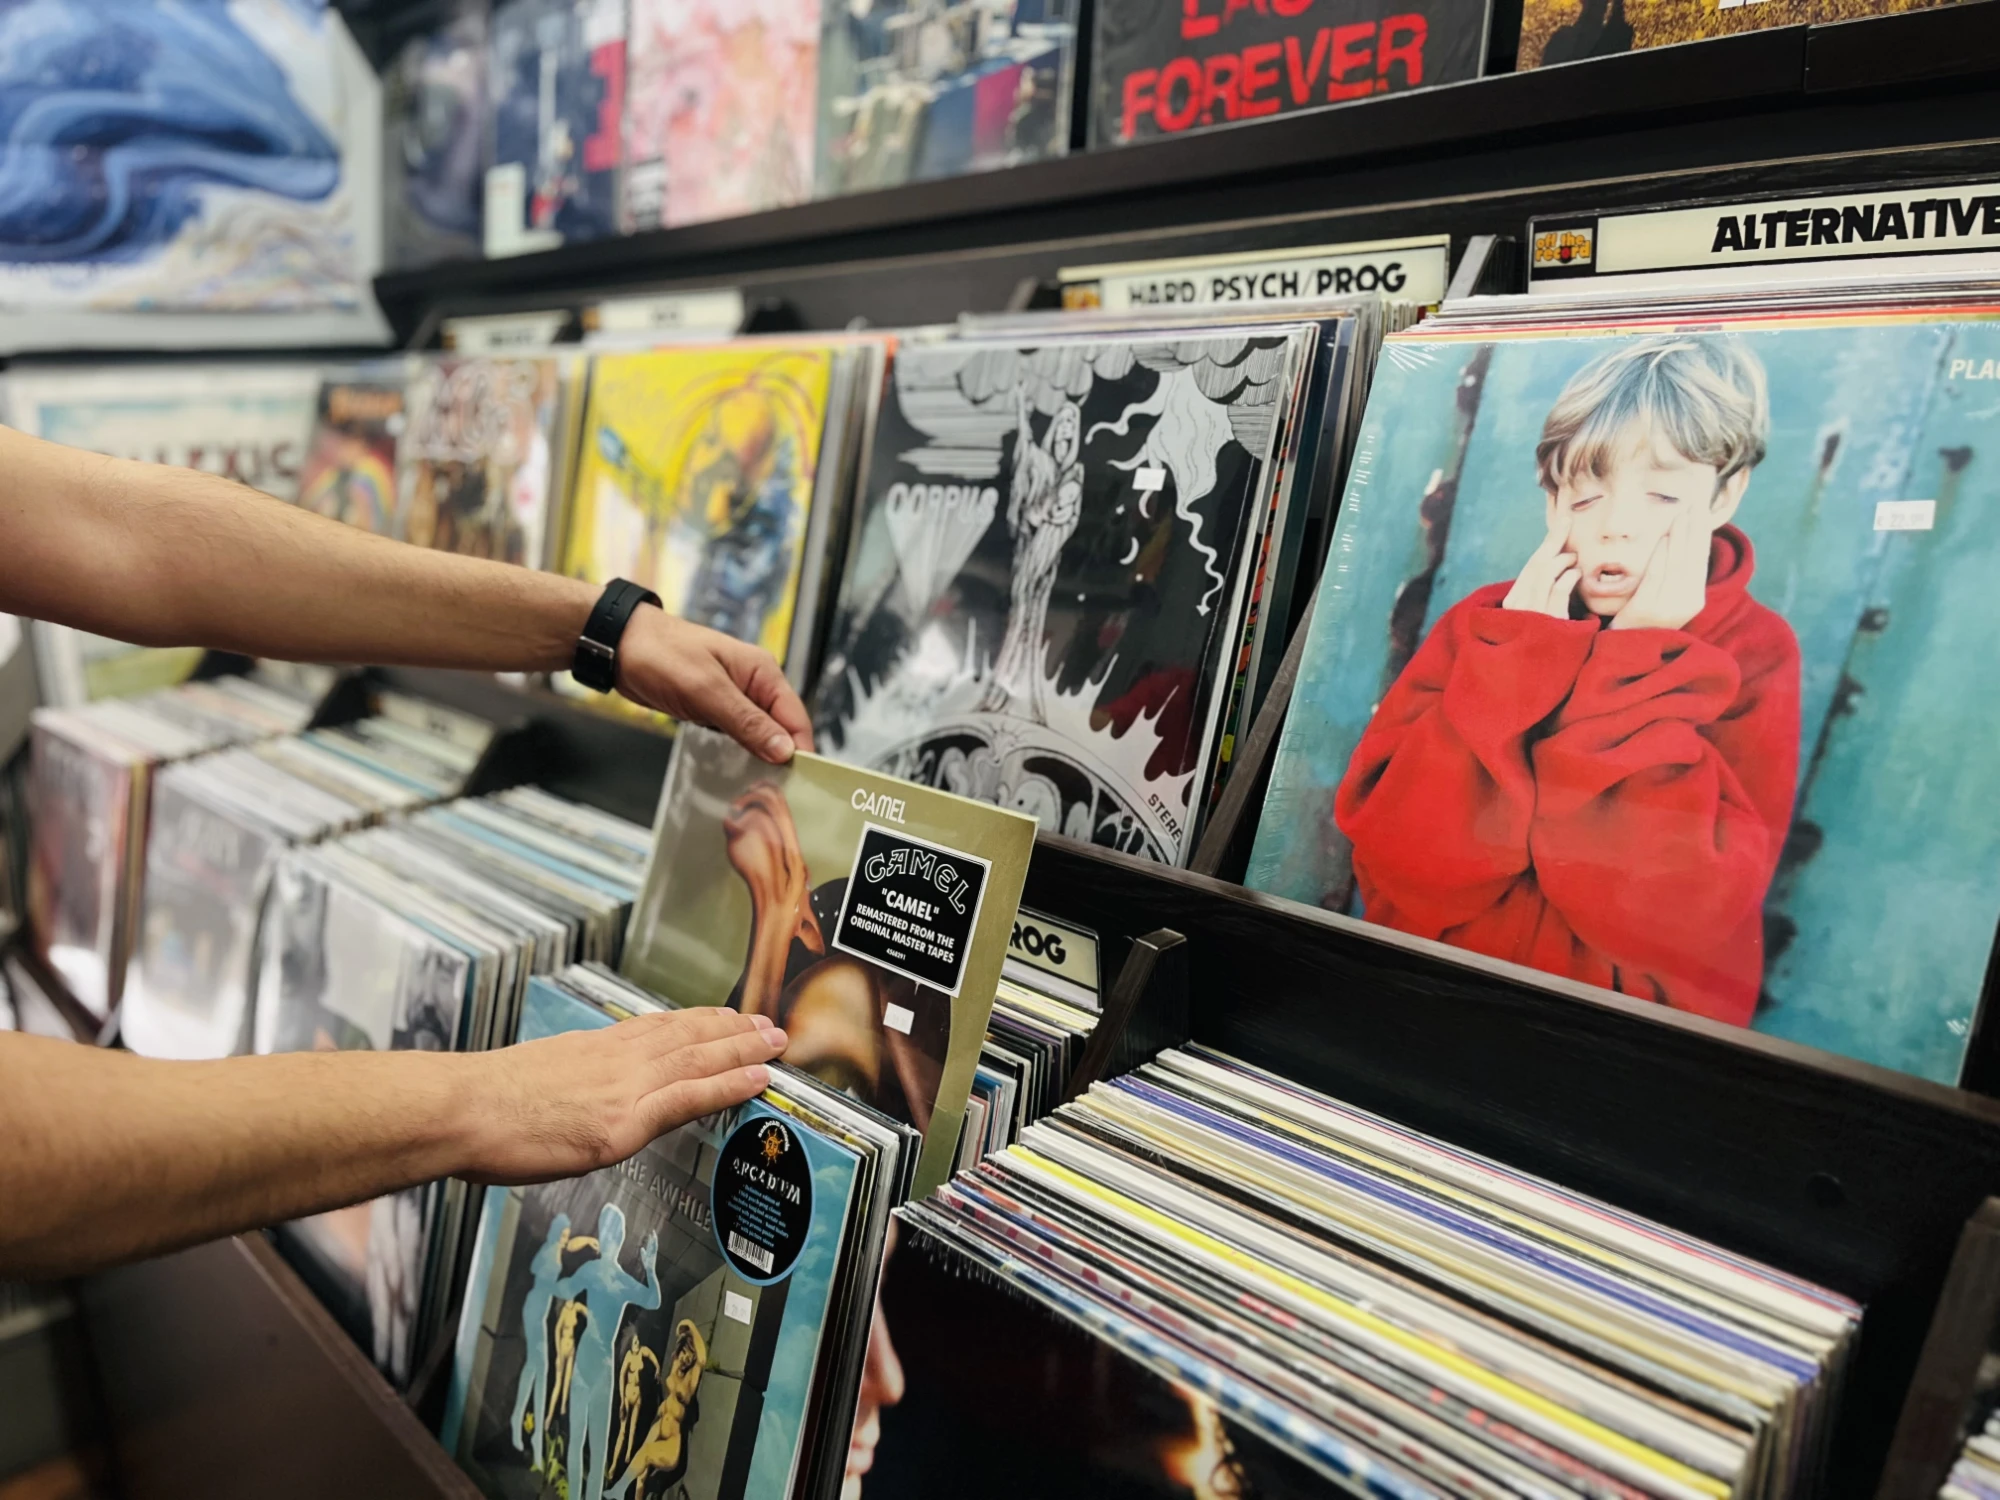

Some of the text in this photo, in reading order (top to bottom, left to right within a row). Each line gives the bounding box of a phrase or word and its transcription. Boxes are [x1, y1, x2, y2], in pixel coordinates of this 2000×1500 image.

[1121, 13, 1428, 142] FOREVER
[1535, 231, 1585, 249] off the
[1711, 195, 2000, 253] ALTERNATIVE
[1535, 240, 1591, 263] record
[1948, 359, 2000, 379] PLA
[851, 788, 906, 824] CAMEL
[1148, 793, 1183, 848] STERE
[865, 848, 969, 915] CAMEL
[881, 887, 940, 922] "CAMEL"
[850, 915, 955, 964] ORIGINAL MASTER TAPES
[856, 903, 955, 949] REMASTERED FROM THE
[1009, 920, 1066, 965] ROG
[649, 1173, 712, 1233] AWHILE
